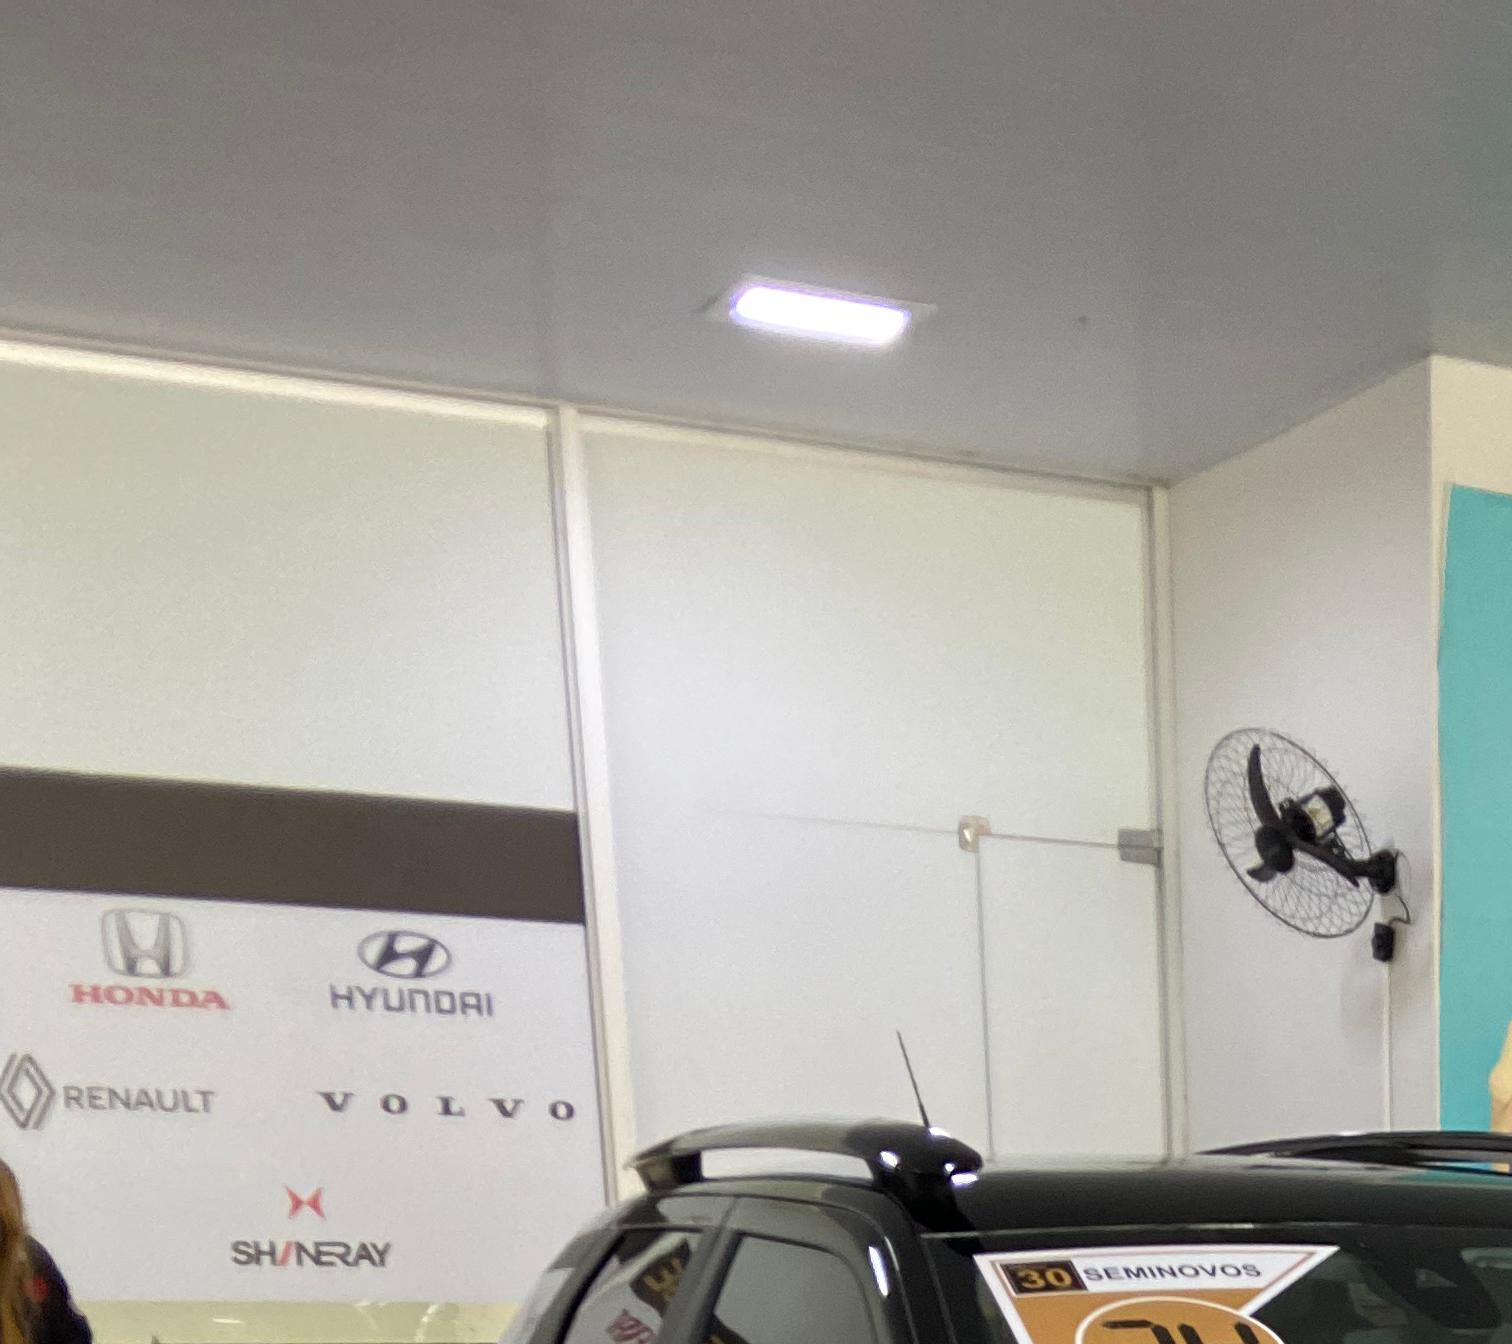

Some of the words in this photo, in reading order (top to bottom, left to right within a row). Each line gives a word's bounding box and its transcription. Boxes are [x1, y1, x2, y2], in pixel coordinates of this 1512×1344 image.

[69, 984, 230, 1010] HONDA
[329, 984, 494, 1017] HYUNDAI
[62, 1085, 215, 1113] RENAULT
[317, 1091, 575, 1121] VOLVO
[231, 1240, 391, 1267] SHINERAY
[1016, 1267, 1073, 1289] 30
[1083, 1263, 1262, 1281] SEMINOVOS
